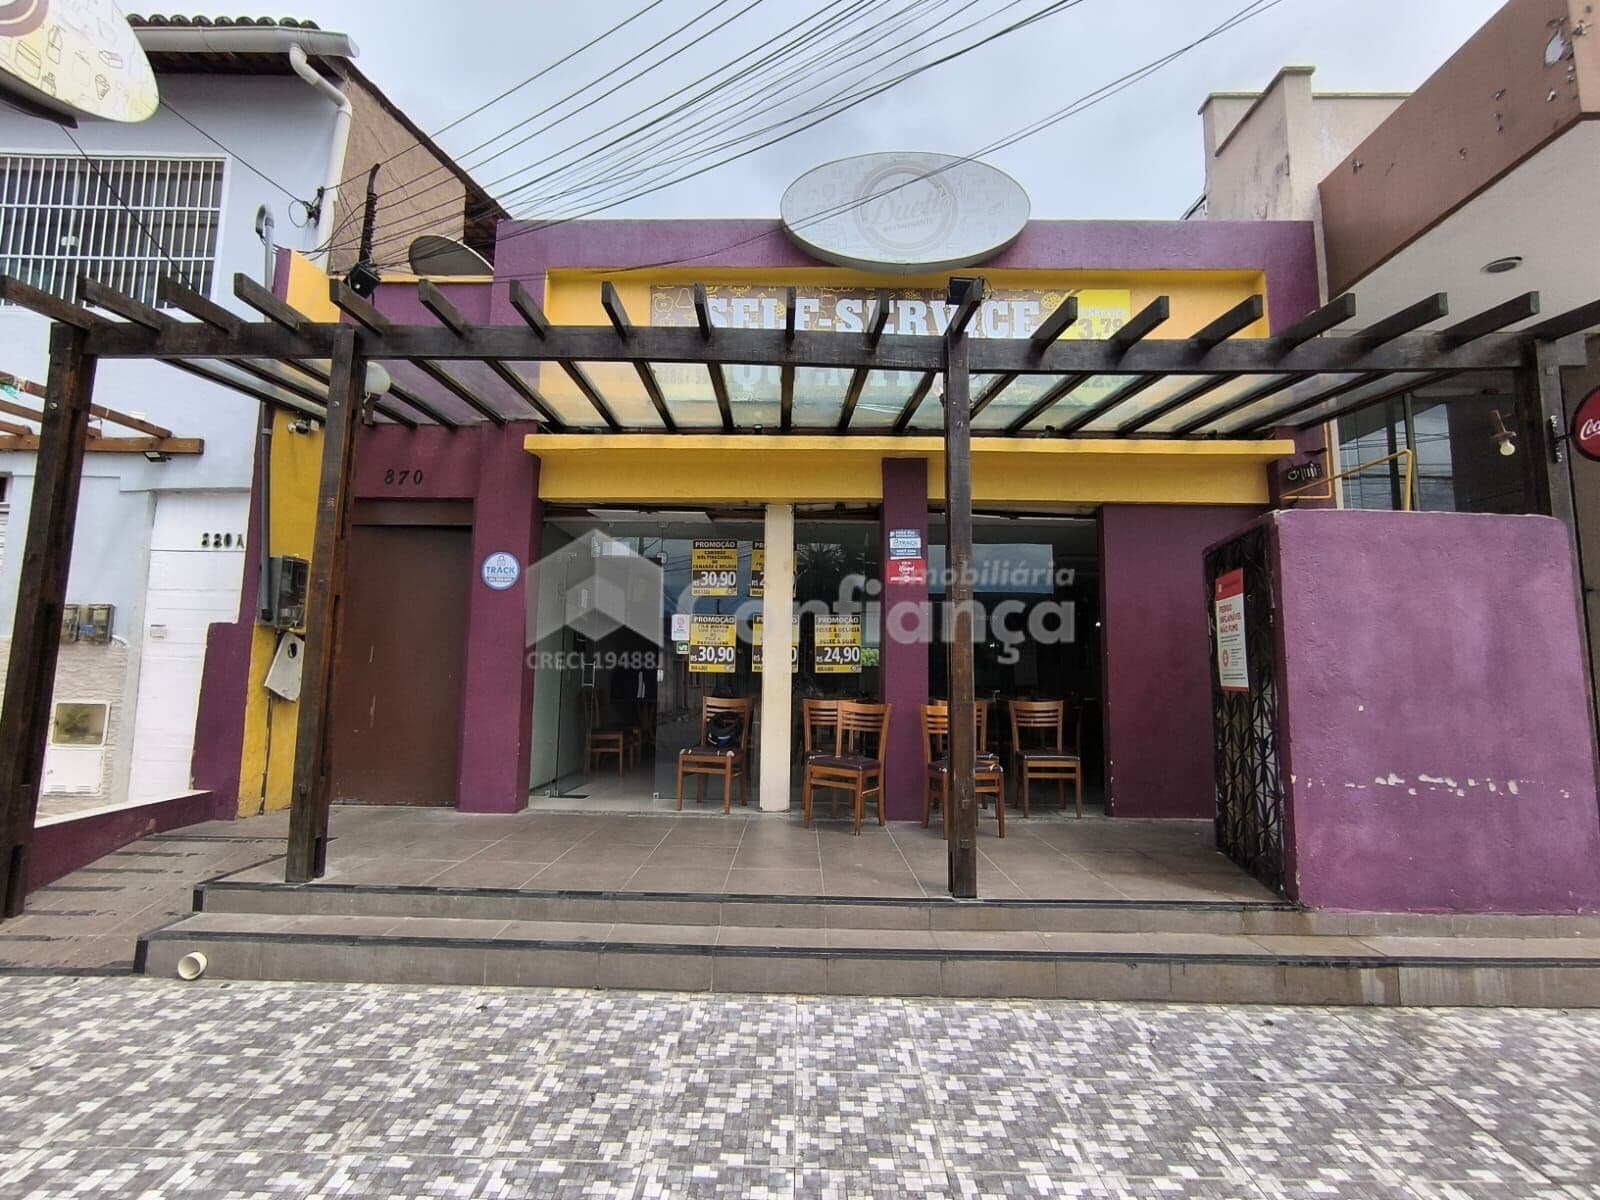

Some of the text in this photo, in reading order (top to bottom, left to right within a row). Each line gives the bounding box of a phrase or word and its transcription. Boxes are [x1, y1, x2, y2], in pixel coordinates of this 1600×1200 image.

[384, 469, 423, 486] 870
[695, 541, 736, 550] PROMOÇÃO
[486, 566, 516, 574] TRACK
[700, 571, 737, 588] 30,90
[694, 615, 735, 625] PROMOÇÃO
[817, 615, 859, 625] PROMOÇÃO
[698, 646, 735, 663] 30,90
[823, 647, 860, 664] 24,90
